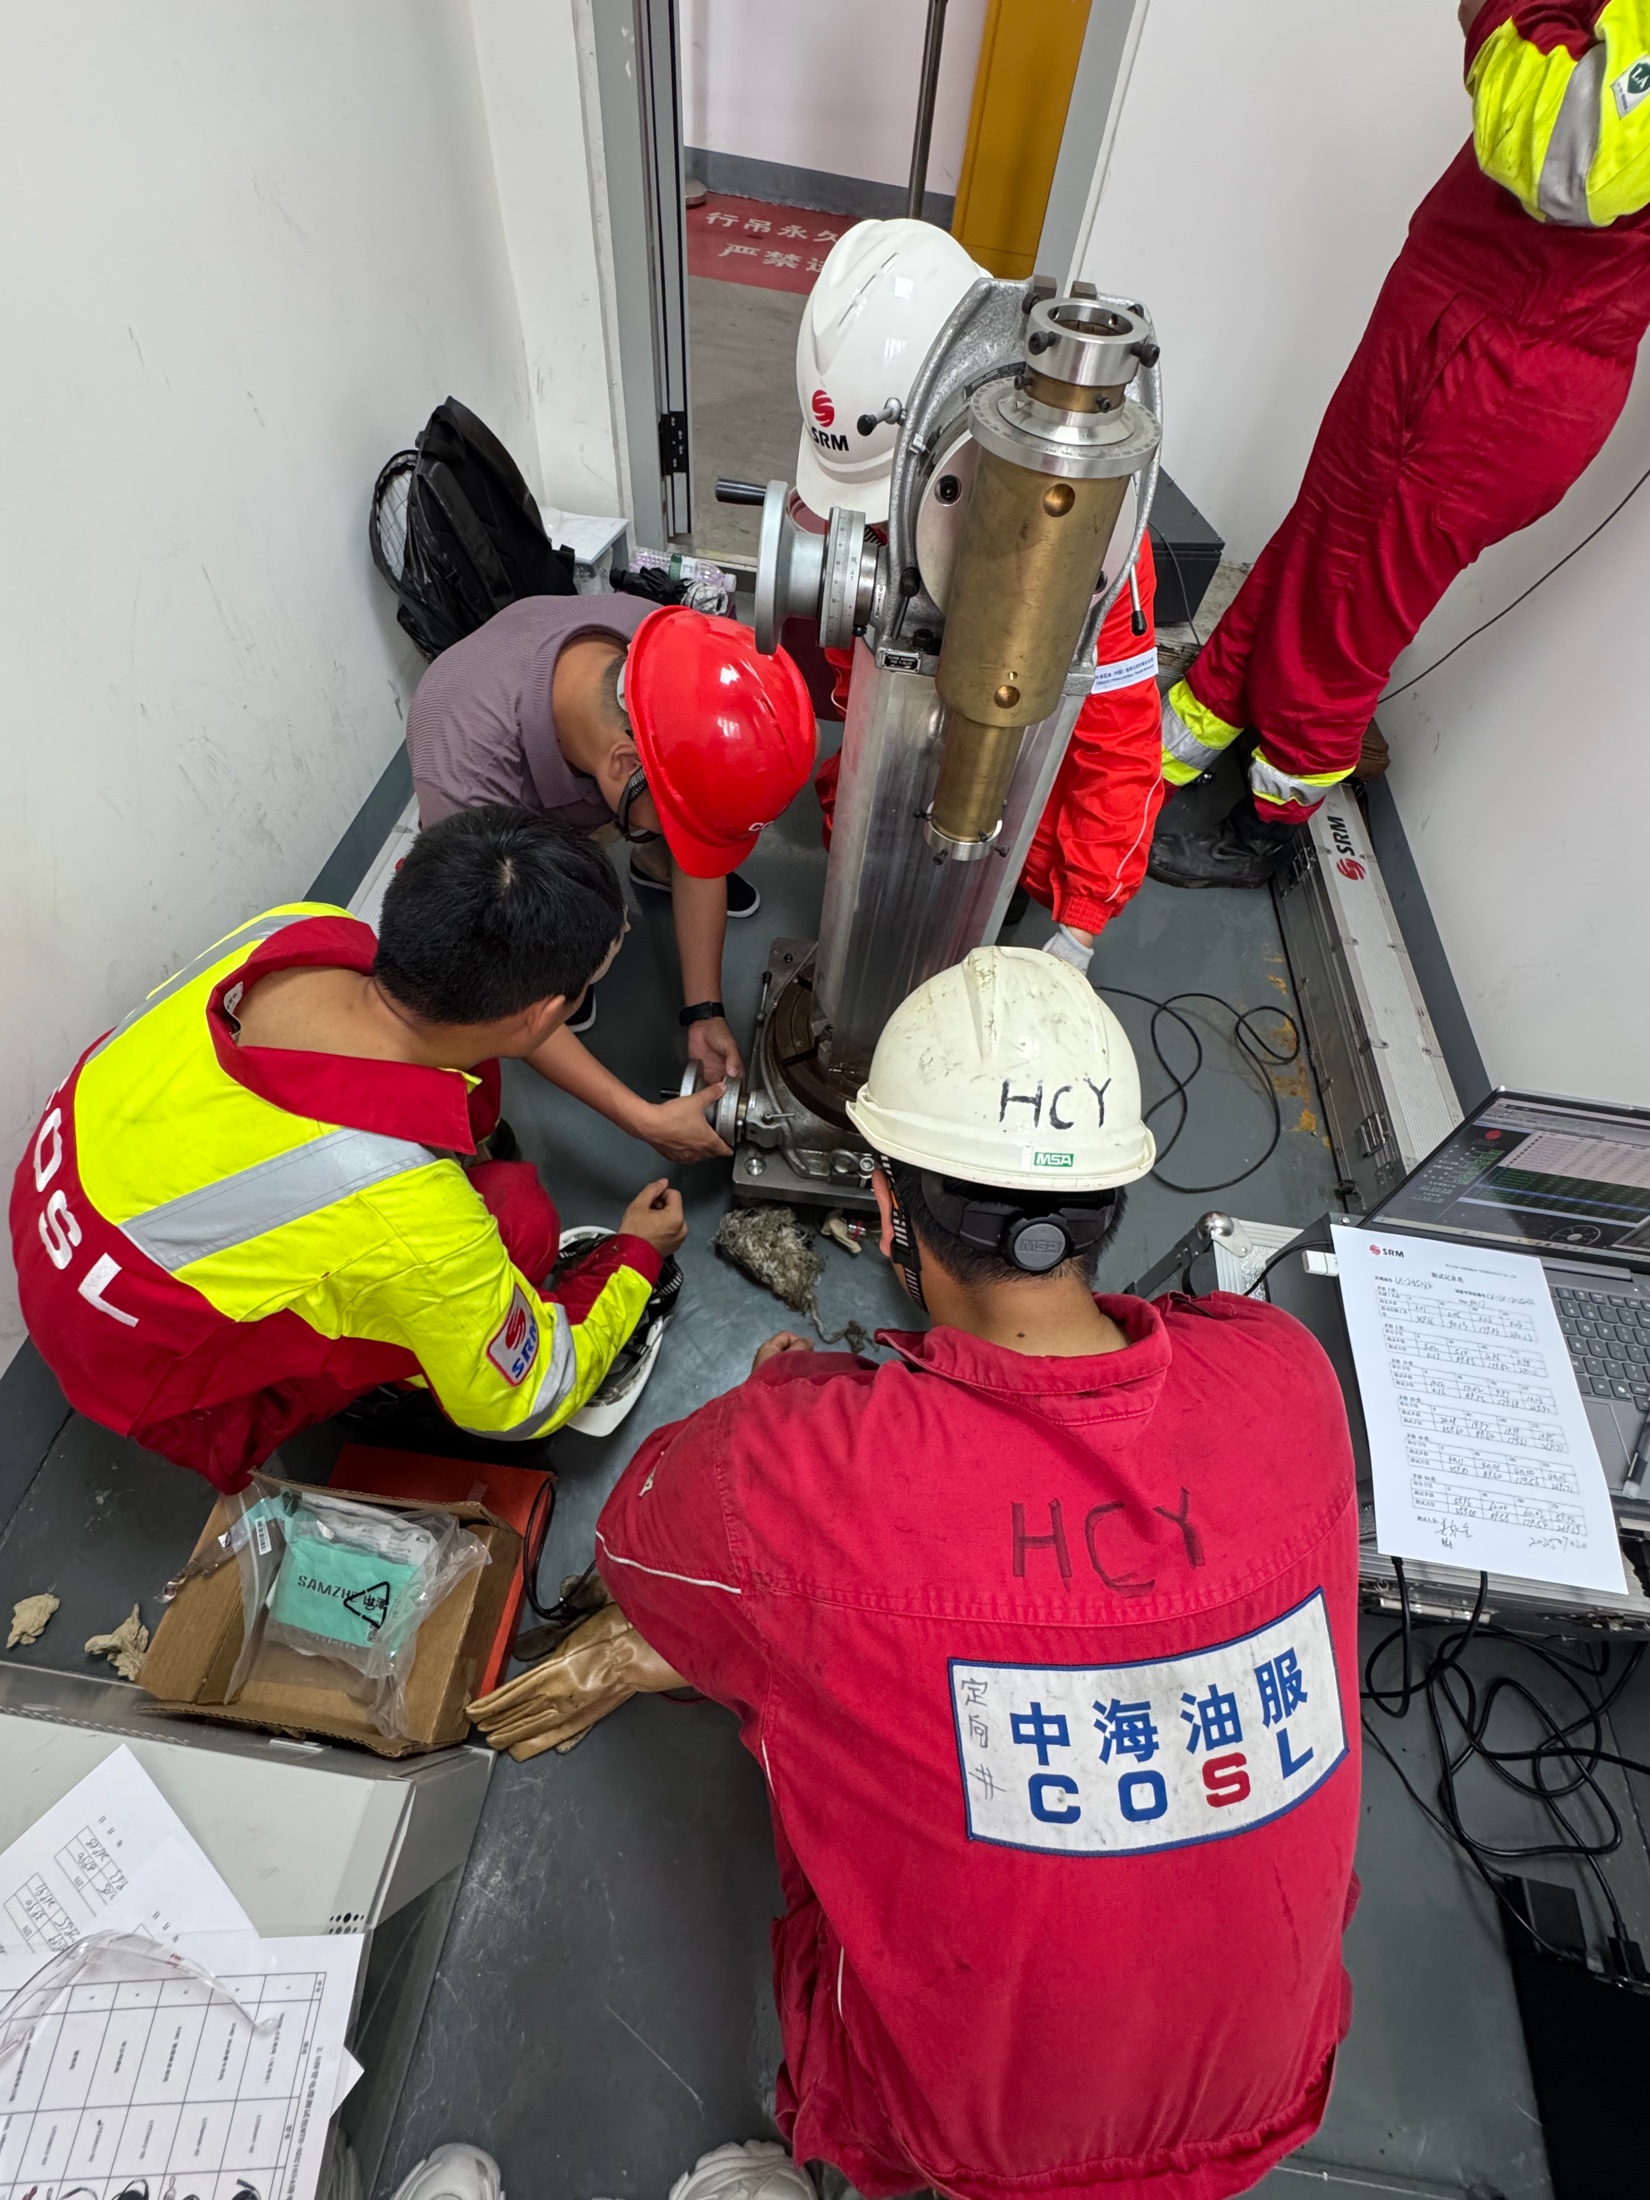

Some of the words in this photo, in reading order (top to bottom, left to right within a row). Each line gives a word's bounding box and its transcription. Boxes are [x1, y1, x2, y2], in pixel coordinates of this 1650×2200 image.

[706, 212, 838, 243] 行吊永久
[811, 426, 849, 451] SRM
[1326, 815, 1355, 856] SRM
[999, 1077, 1112, 1130] HCY
[1035, 1153, 1072, 1166] MSA
[34, 1076, 140, 1328] OSL
[1020, 1240, 1061, 1252] MSA
[1382, 1247, 1405, 1258] SRM
[511, 1313, 537, 1379] SRM
[1011, 1486, 1205, 1599] HCY
[1010, 1647, 1308, 1767] 中海油服
[1028, 1727, 1314, 1826] COSL
